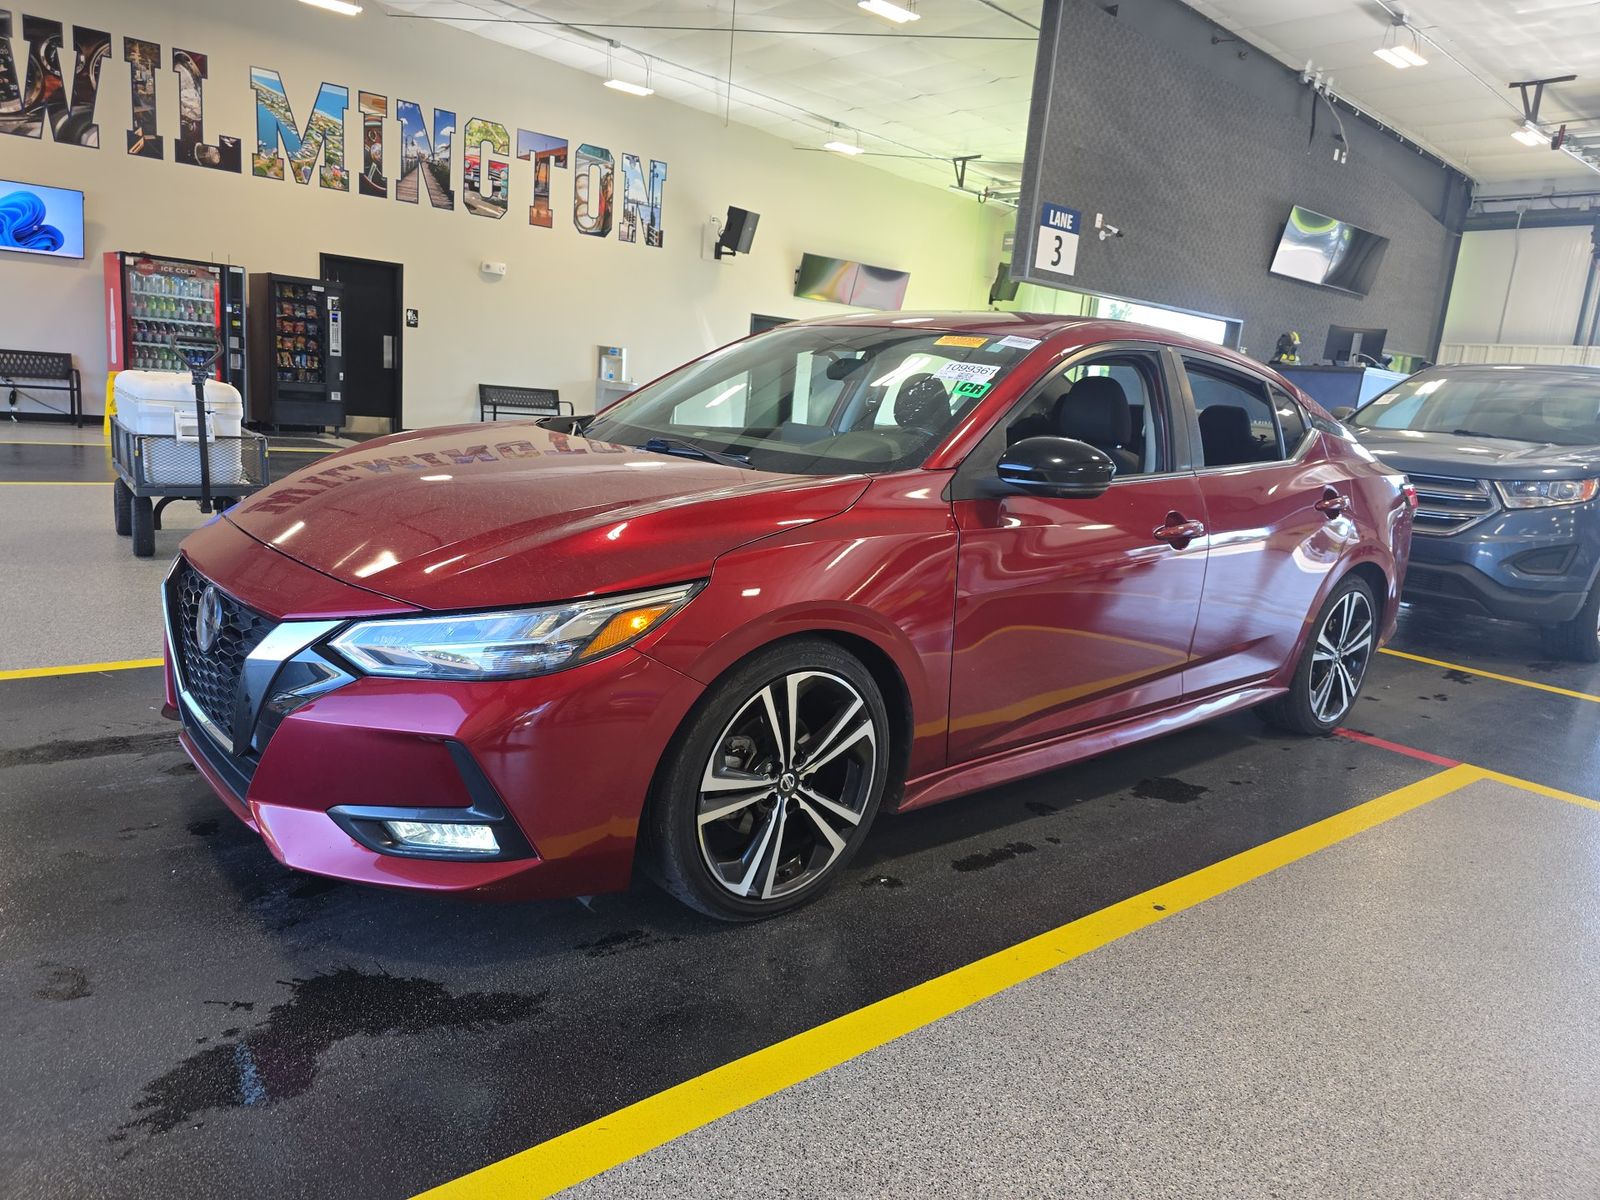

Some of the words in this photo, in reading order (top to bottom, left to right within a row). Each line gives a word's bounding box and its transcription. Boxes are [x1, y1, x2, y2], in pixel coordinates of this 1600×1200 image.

[0, 9, 668, 248] WILMINGTON
[1049, 209, 1073, 229] LANE
[1050, 235, 1063, 267] 3
[175, 267, 197, 275] COLD
[946, 363, 997, 376] 1099361
[958, 382, 985, 394] CR
